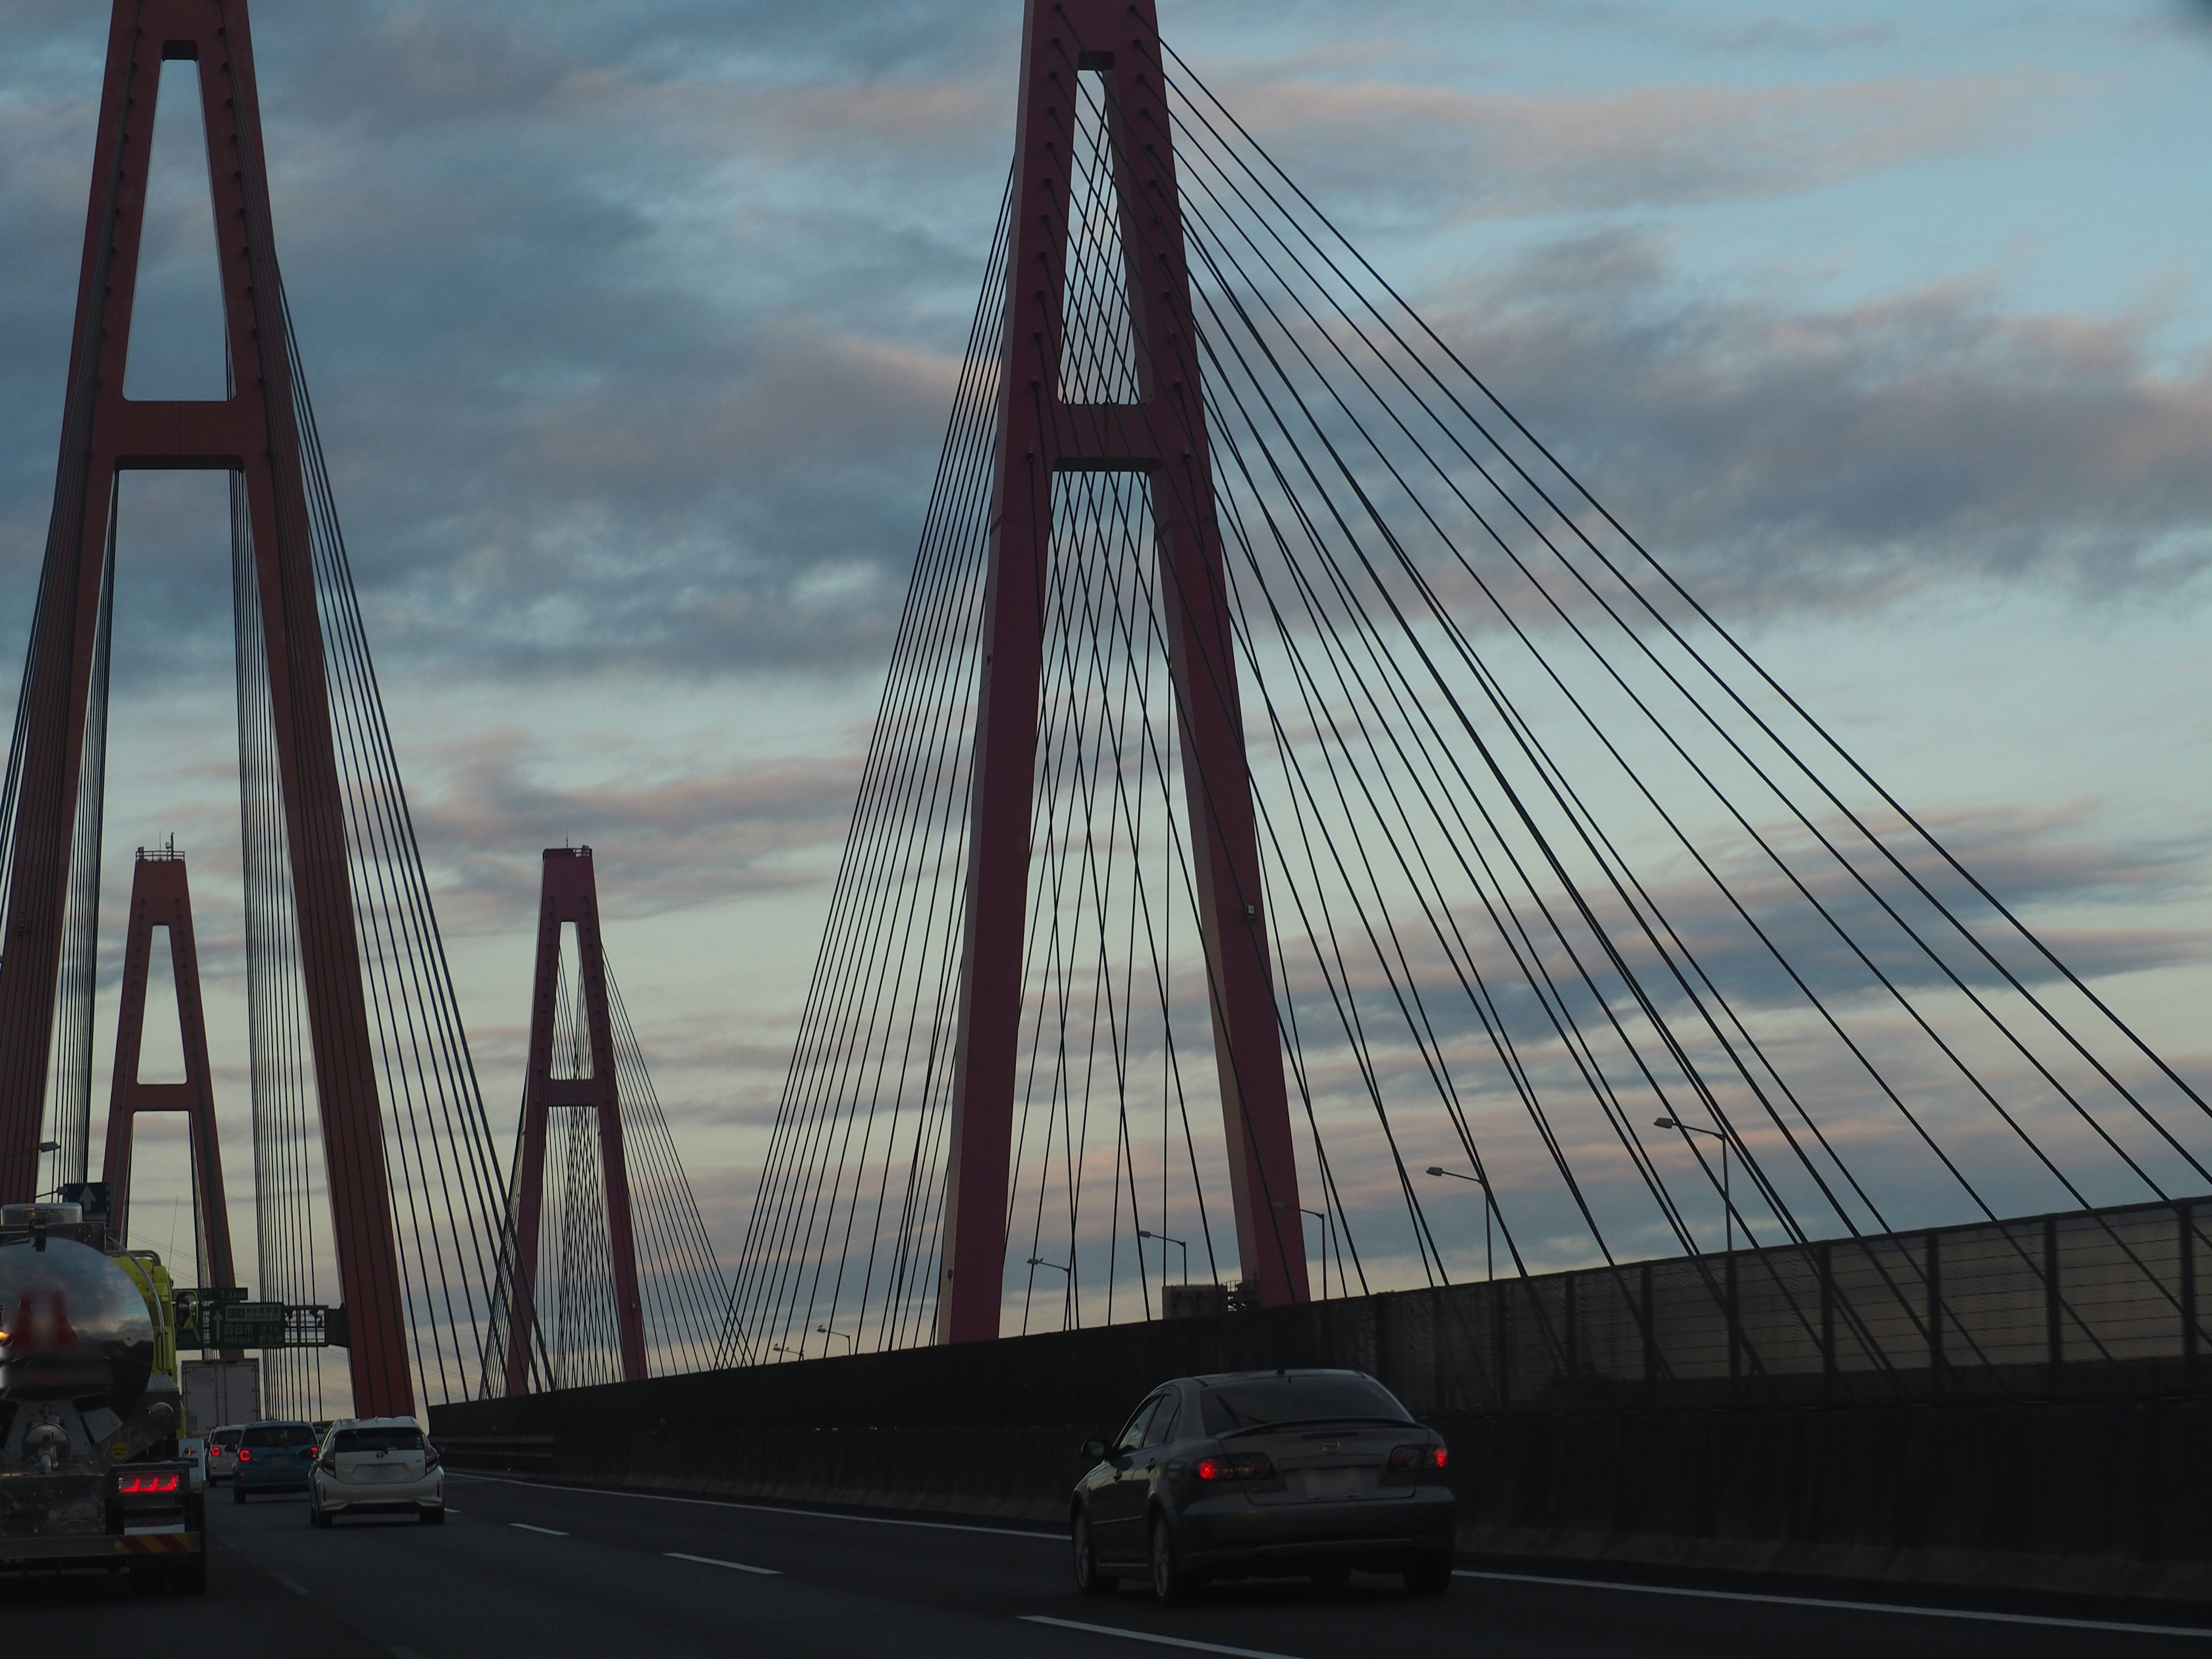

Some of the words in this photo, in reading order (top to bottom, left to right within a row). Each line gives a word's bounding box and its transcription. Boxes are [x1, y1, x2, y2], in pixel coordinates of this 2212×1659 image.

[220, 1290, 247, 1298] 1.2km
[225, 1324, 253, 1335] 四日市
[224, 1336, 253, 1344] Yokkaichi
